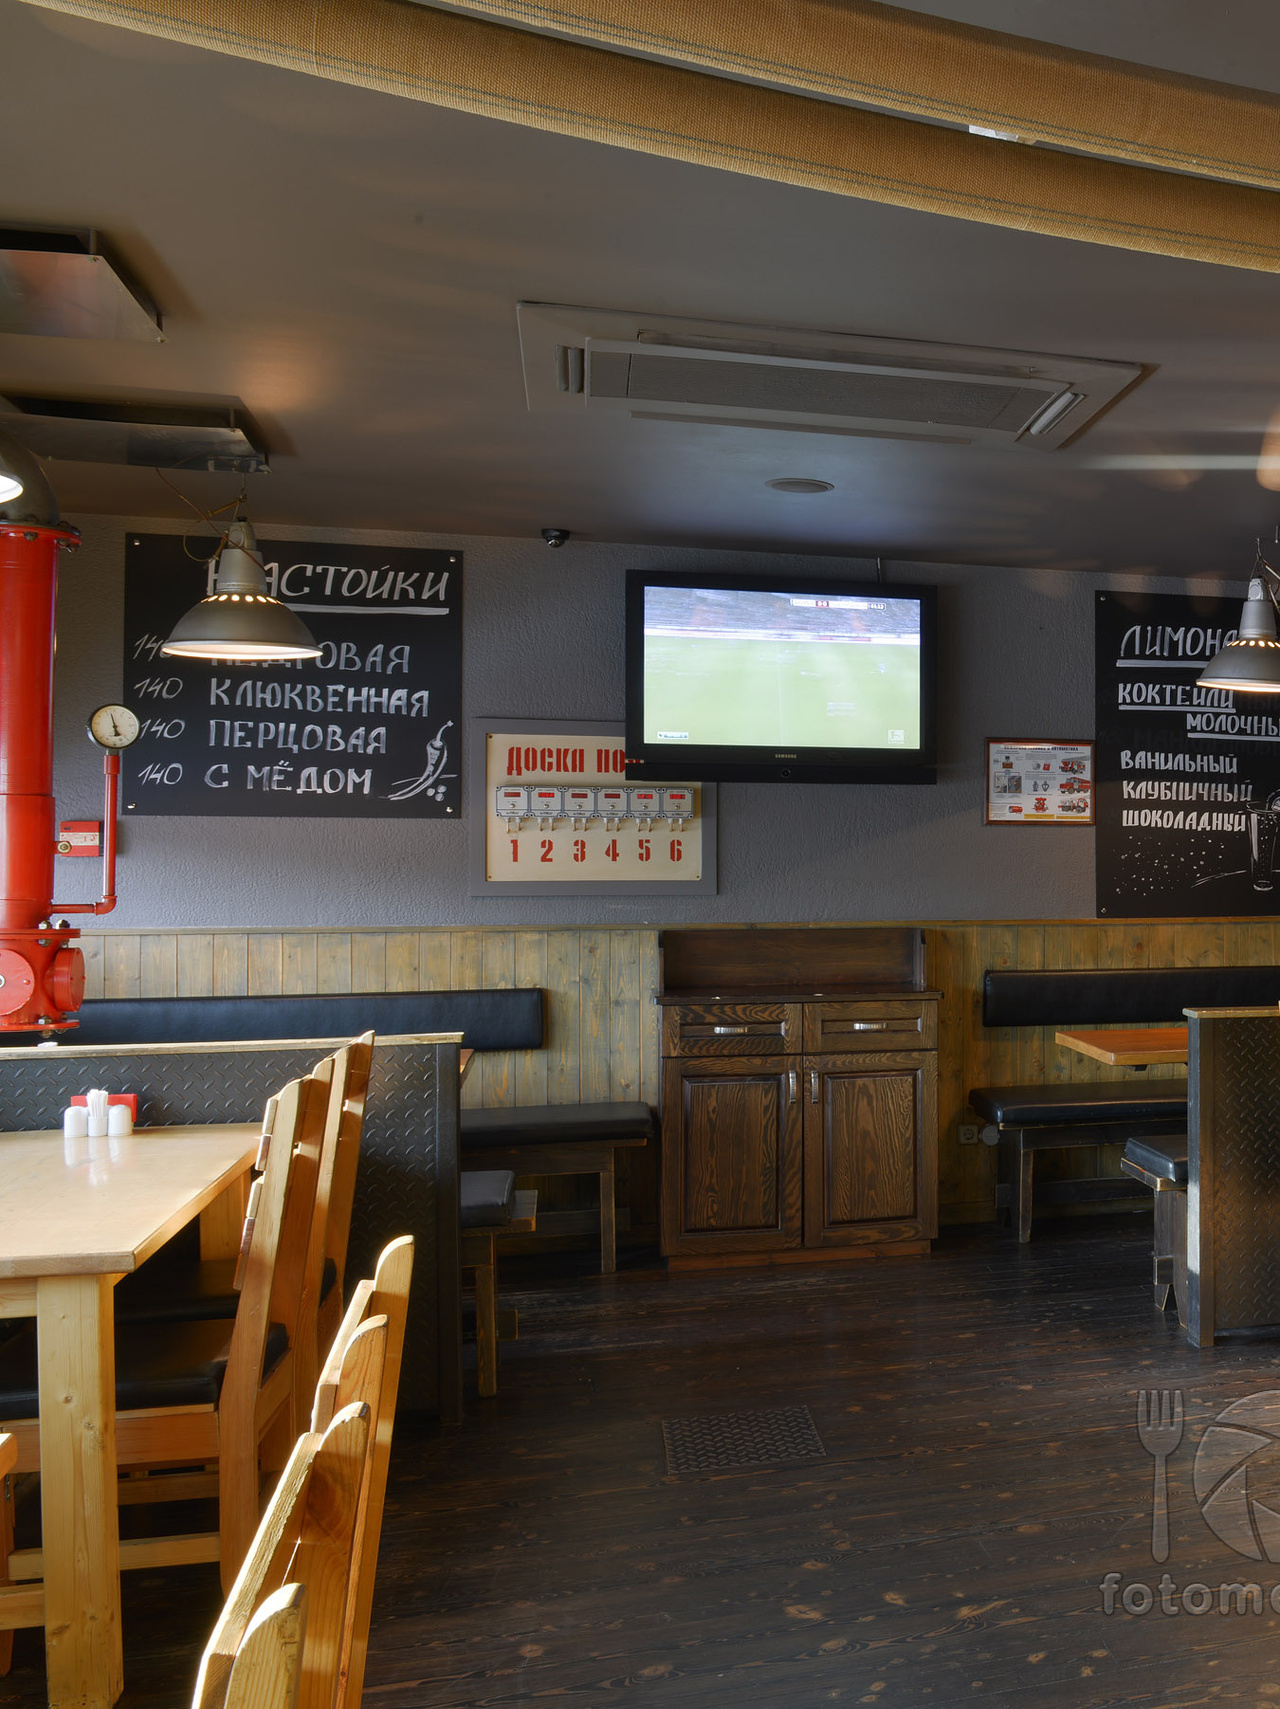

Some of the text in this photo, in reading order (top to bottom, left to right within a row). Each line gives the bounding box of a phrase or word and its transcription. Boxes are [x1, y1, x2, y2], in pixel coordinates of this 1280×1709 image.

[133, 634, 172, 660] 14
[133, 677, 429, 717] 140 КЛЮКВЕННАЯ
[141, 718, 387, 754] 140 ПЕРЦОВАЯ
[1120, 750, 1238, 774] ВАНИЛЬНЫЙ
[138, 759, 373, 795] 140 С МЁДОМ
[1122, 780, 1252, 803] КЛУБНИЧНЫЙ
[1122, 809, 1246, 832] ШОКОЛАДНЫЙ
[510, 839, 683, 862] 1 2 3 4 5 6
